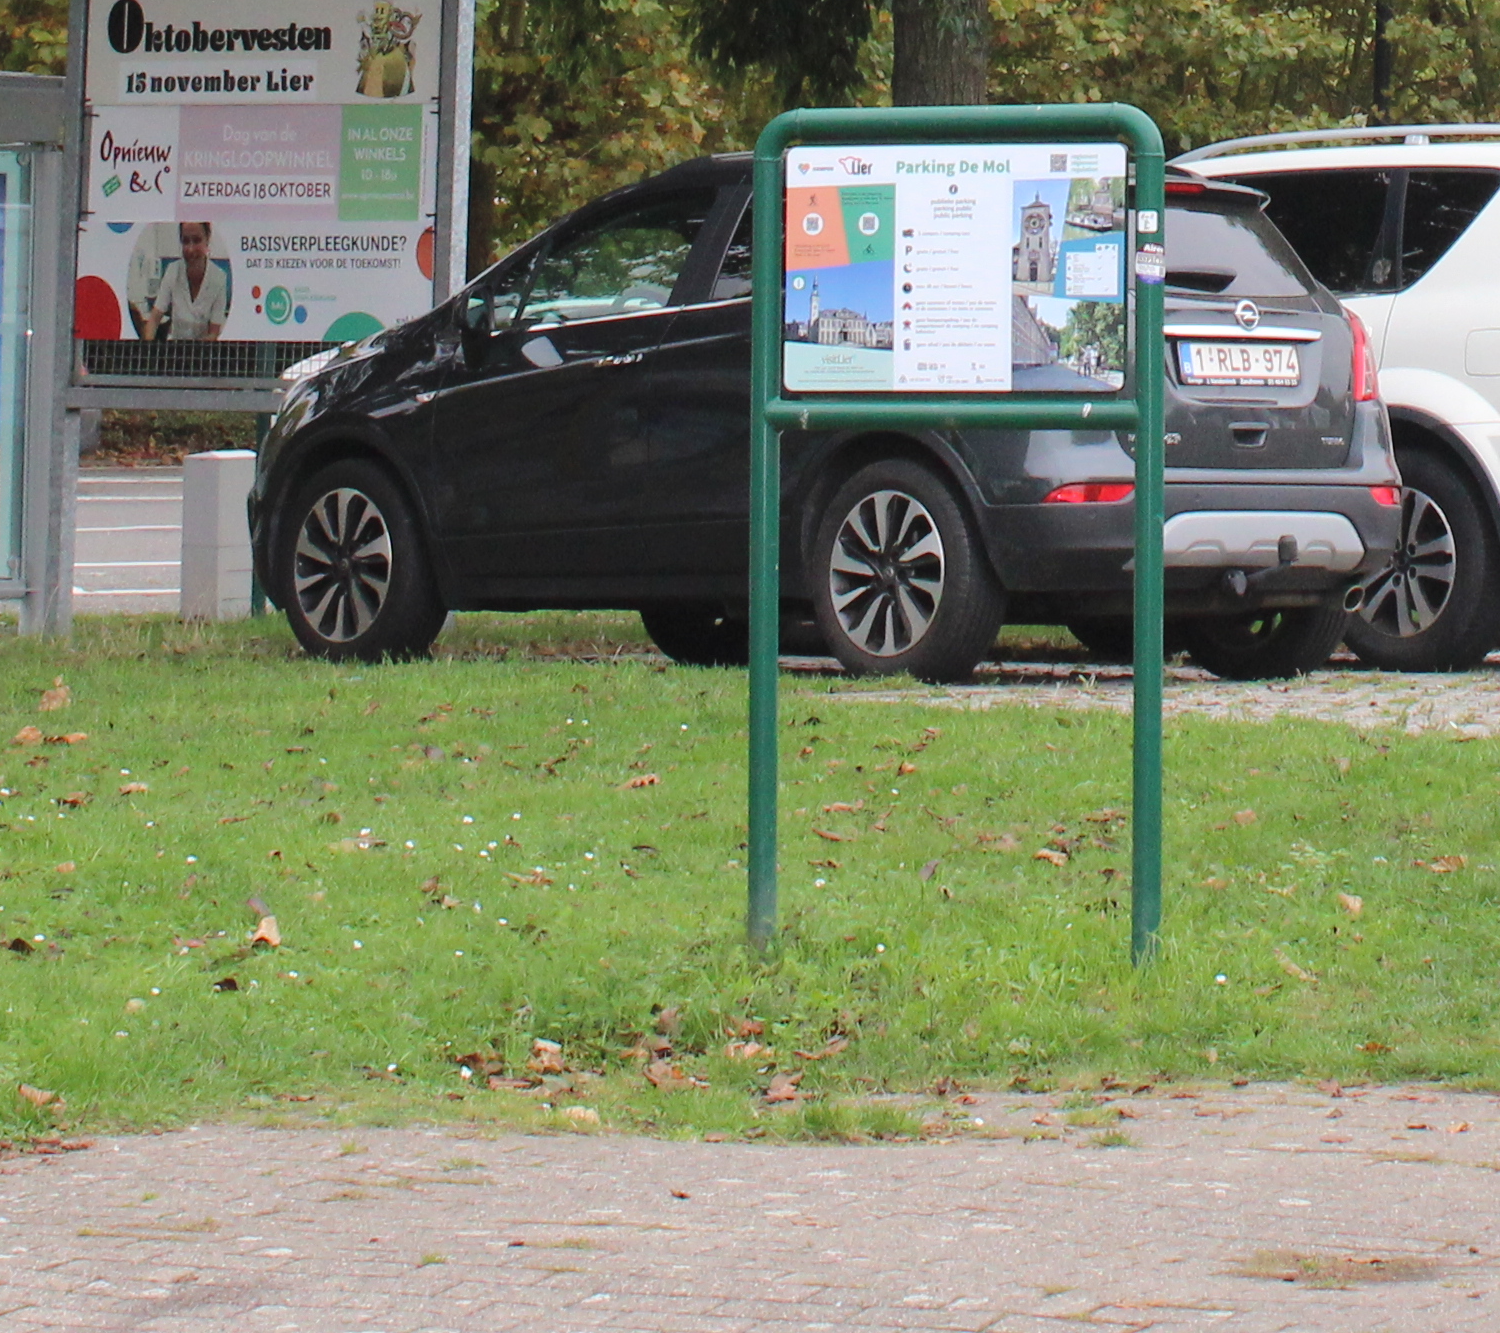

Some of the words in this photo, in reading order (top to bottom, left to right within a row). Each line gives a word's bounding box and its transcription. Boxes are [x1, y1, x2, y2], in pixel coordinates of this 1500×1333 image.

[126, 72, 146, 93] 15
[150, 69, 260, 93] november
[266, 68, 314, 92] Lier
[222, 124, 251, 146] Dag
[253, 131, 277, 141] van
[280, 124, 297, 141] de
[348, 128, 361, 141] IN
[362, 128, 377, 141] AL
[379, 127, 413, 141] ONZE
[100, 130, 172, 169] Opnieuw
[354, 147, 406, 161] WINKELS
[183, 150, 334, 169] KRINGLOOPWINKEL
[852, 159, 873, 175] Lier
[896, 160, 955, 177] Parking
[960, 160, 979, 173] De
[983, 159, 1011, 173] Mol
[129, 171, 151, 192] &
[184, 181, 250, 197] ZATERDAG
[253, 183, 266, 199] 18
[268, 182, 331, 197] OKTOBER
[241, 235, 407, 252] BASISVERPLEEGKUNDE?
[246, 258, 262, 269] DAT
[264, 258, 274, 269] IS
[276, 258, 307, 269] KIEZEN
[310, 258, 334, 269] VOOR
[336, 258, 347, 269] DE
[351, 258, 401, 269] TOEKOMST!
[1184, 362, 1191, 374] B
